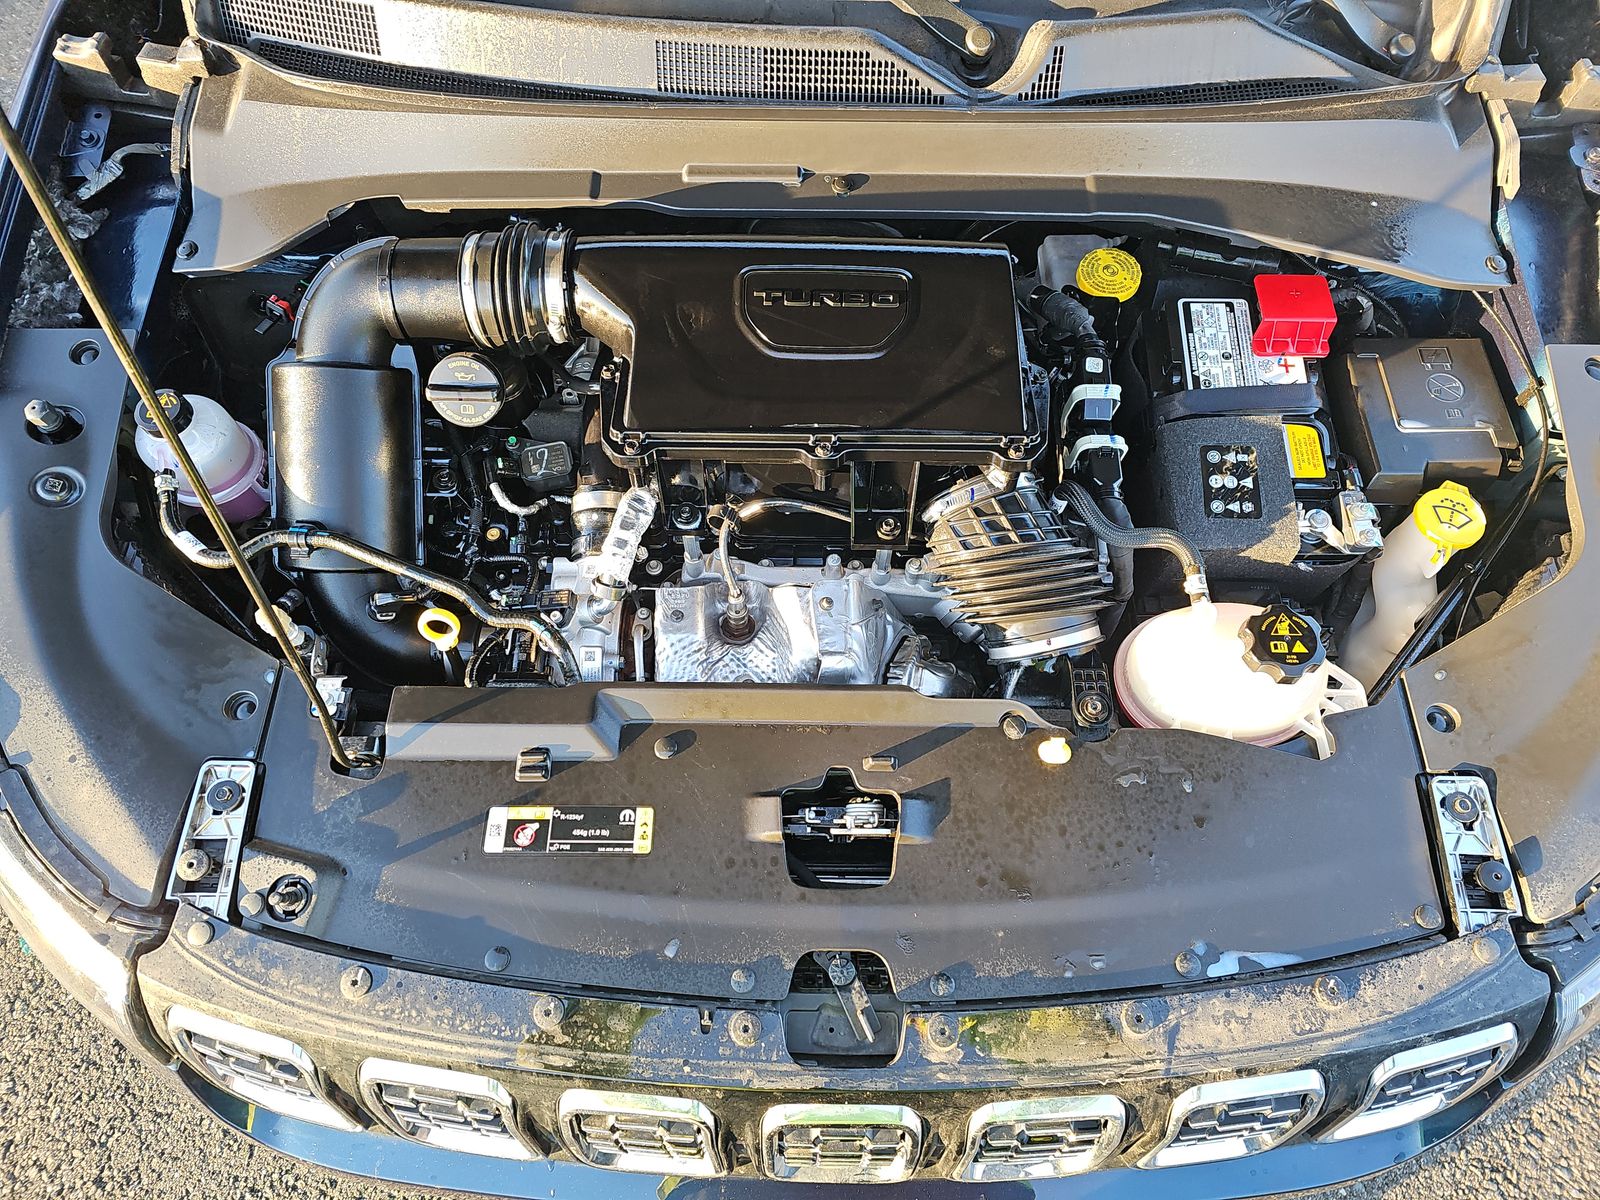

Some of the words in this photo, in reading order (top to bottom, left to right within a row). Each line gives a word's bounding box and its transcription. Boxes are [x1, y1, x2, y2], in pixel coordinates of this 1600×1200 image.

[753, 290, 900, 308] TURBO
[448, 361, 469, 369] ENGINE
[471, 362, 480, 370] OIL
[572, 829, 587, 837] 454g
[588, 829, 600, 837] (1.0
[601, 829, 610, 837] lb)
